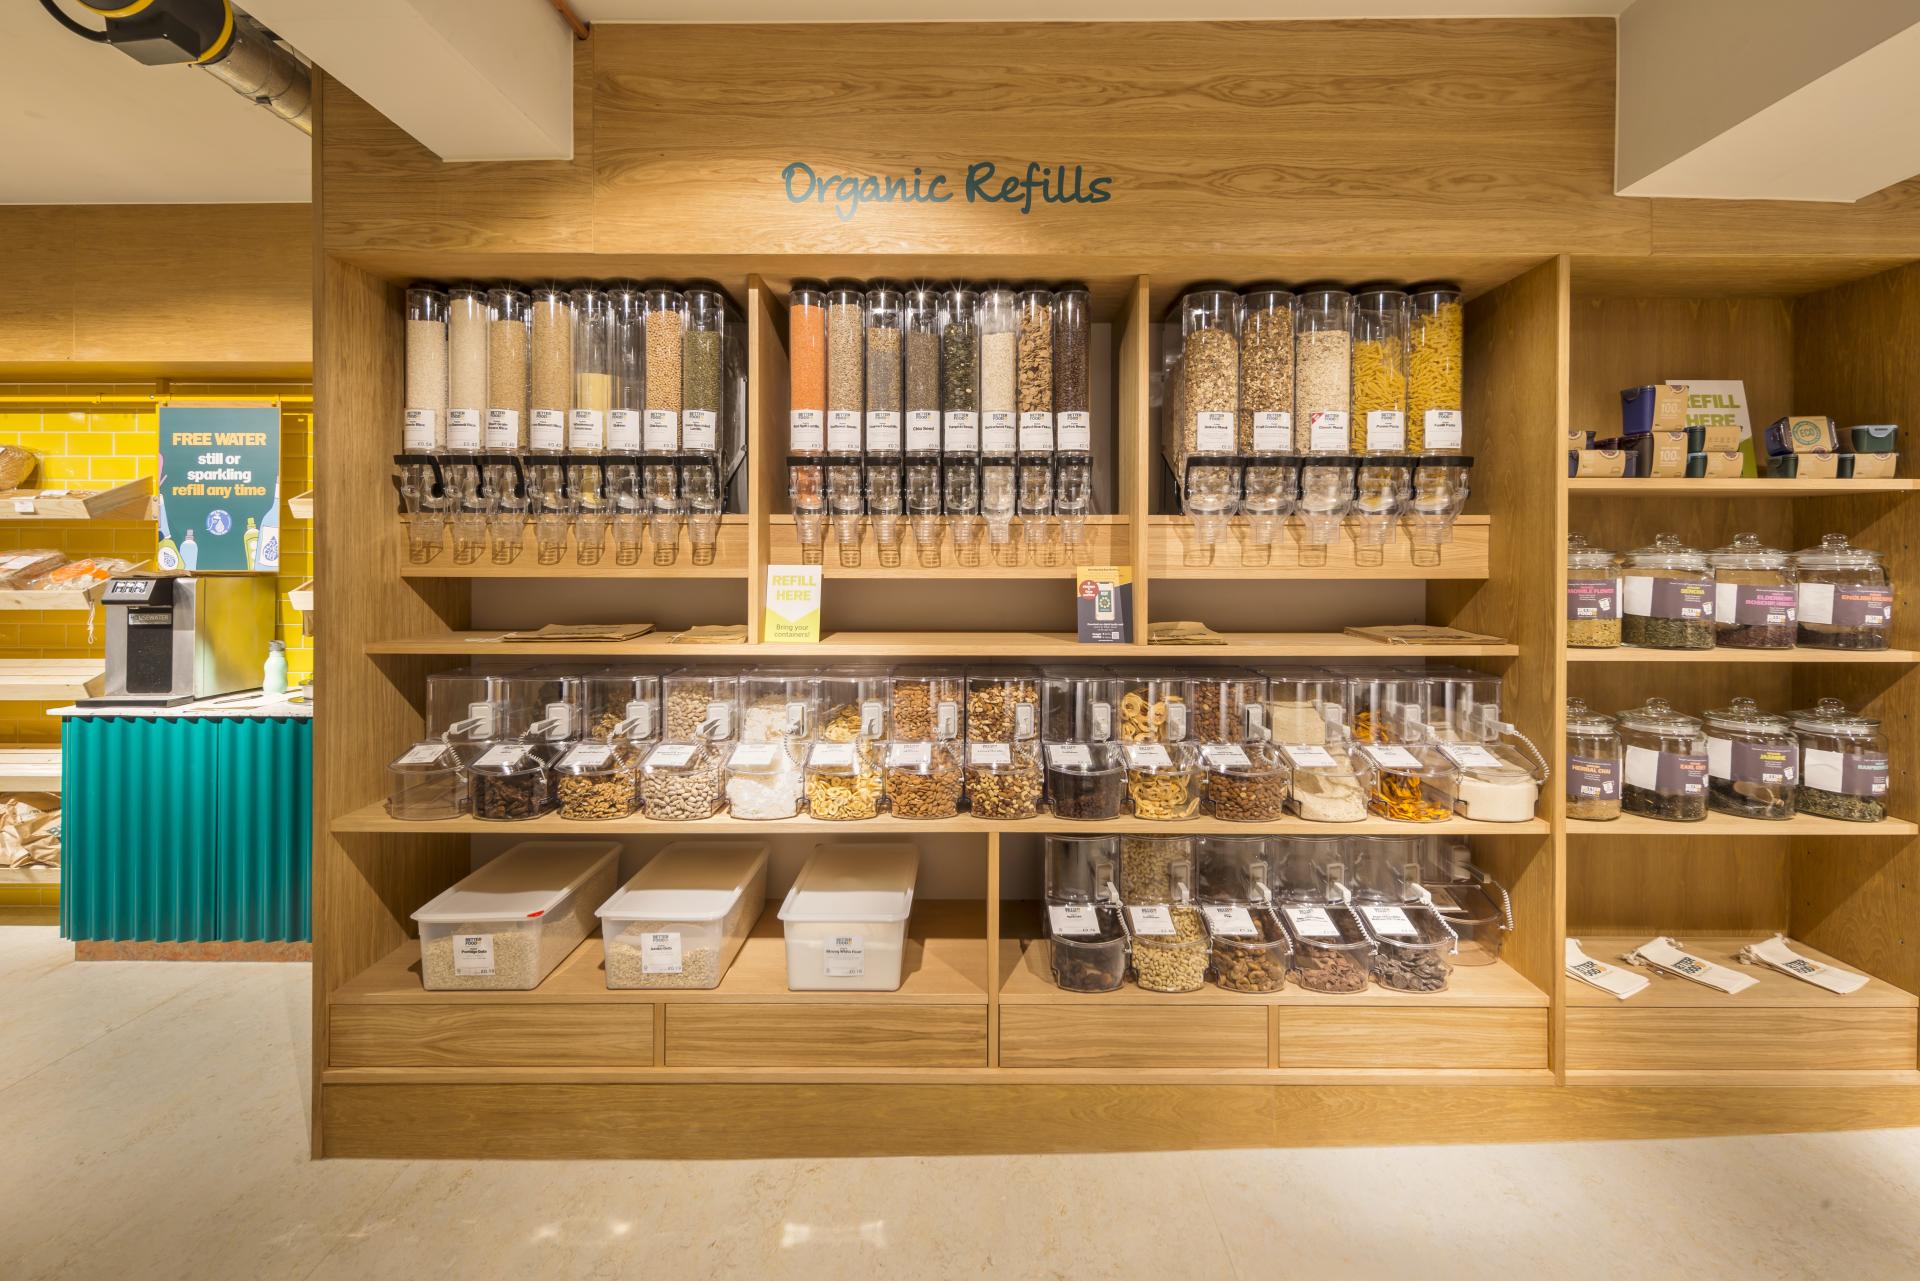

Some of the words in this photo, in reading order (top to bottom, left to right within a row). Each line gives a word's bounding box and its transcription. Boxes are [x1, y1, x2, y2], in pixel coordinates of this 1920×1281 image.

[782, 162, 953, 221] Organic
[966, 161, 1112, 214] Refills
[1685, 413, 1736, 427] HERE
[172, 432, 212, 446] FREE
[214, 432, 267, 446] WATER
[198, 452, 224, 465] still
[225, 456, 241, 465] or
[187, 468, 252, 483] sparkling
[172, 484, 205, 496] refill
[206, 487, 232, 499] any
[234, 484, 266, 496] time
[772, 575, 817, 587] REFILL
[776, 590, 812, 601] HERE
[776, 623, 793, 631] Bring
